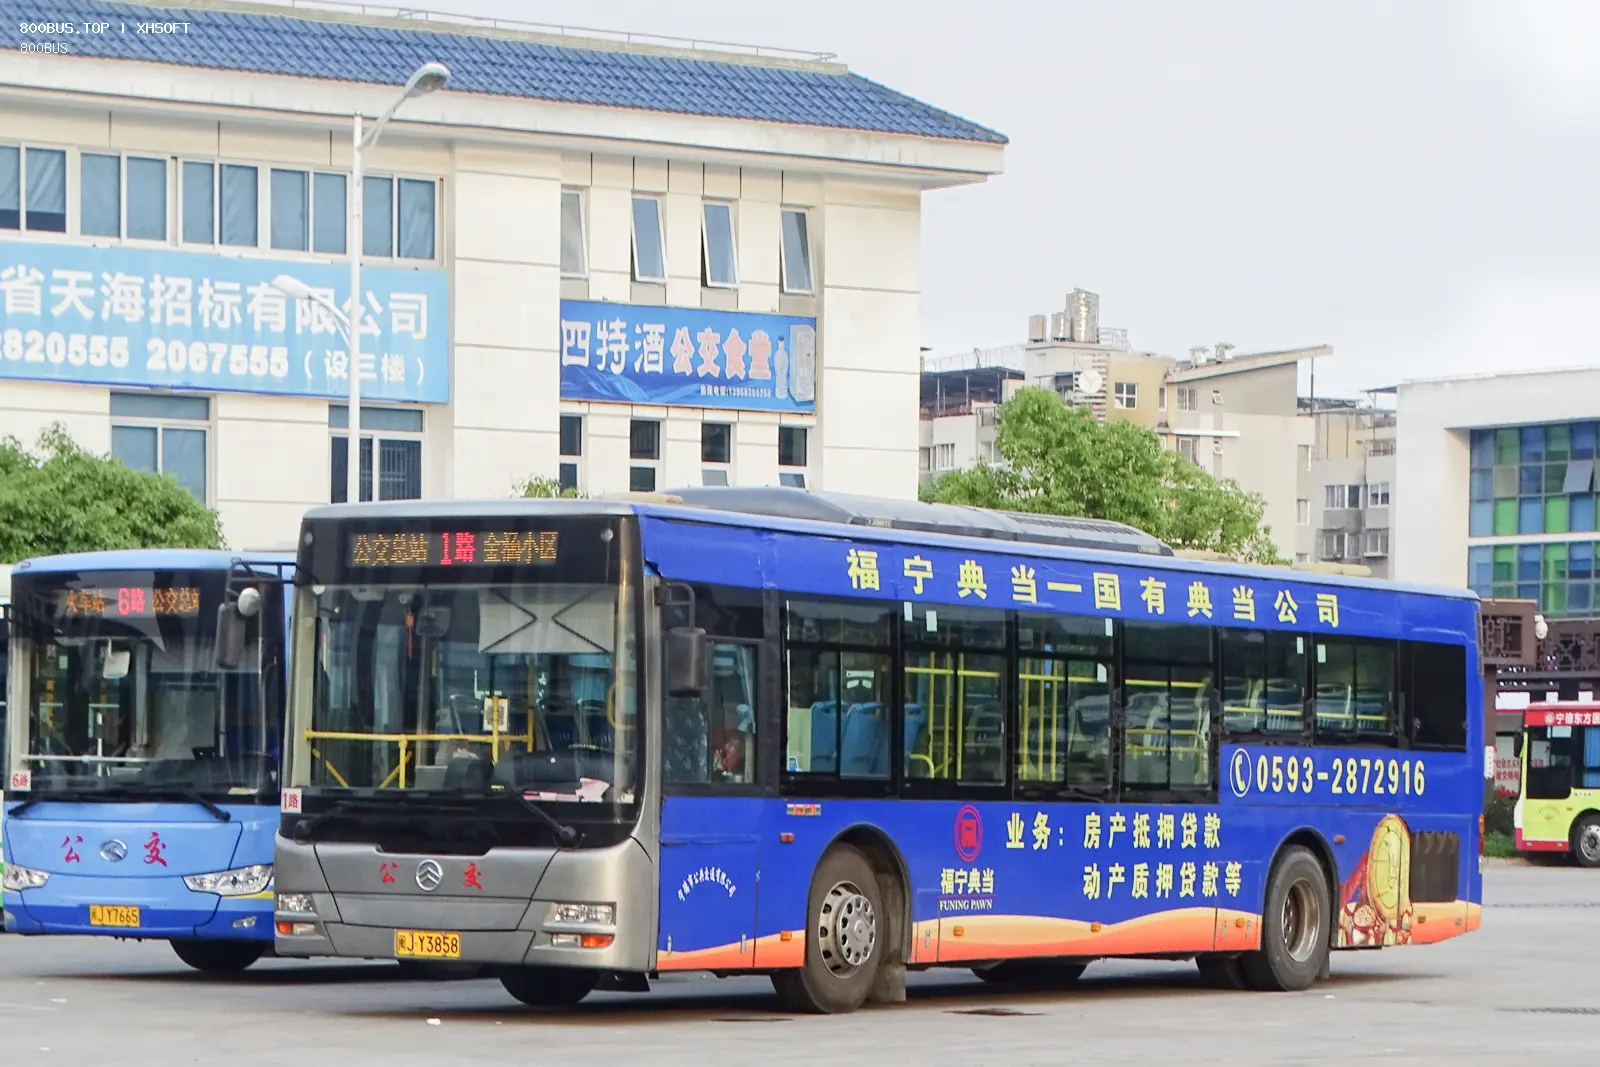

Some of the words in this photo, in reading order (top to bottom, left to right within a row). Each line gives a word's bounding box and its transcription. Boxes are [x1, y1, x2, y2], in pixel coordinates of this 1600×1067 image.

[0, 264, 428, 340] 省天海招标有限公司
[0, 328, 130, 368] 820555
[146, 338, 289, 378] 2067555
[561, 317, 666, 375] 四特酒
[669, 325, 773, 381] 公交食堂
[353, 533, 429, 566] 公交总站
[440, 531, 476, 565] 1路
[117, 587, 145, 616] 6路
[1256, 754, 1425, 796] 0593-2872916
[283, 792, 298, 809] 1路
[940, 867, 995, 895] 福宁典当
[1082, 861, 1243, 900] 动产质押贷款等
[939, 898, 970, 911] FUNING
[970, 898, 993, 910] PAWN
